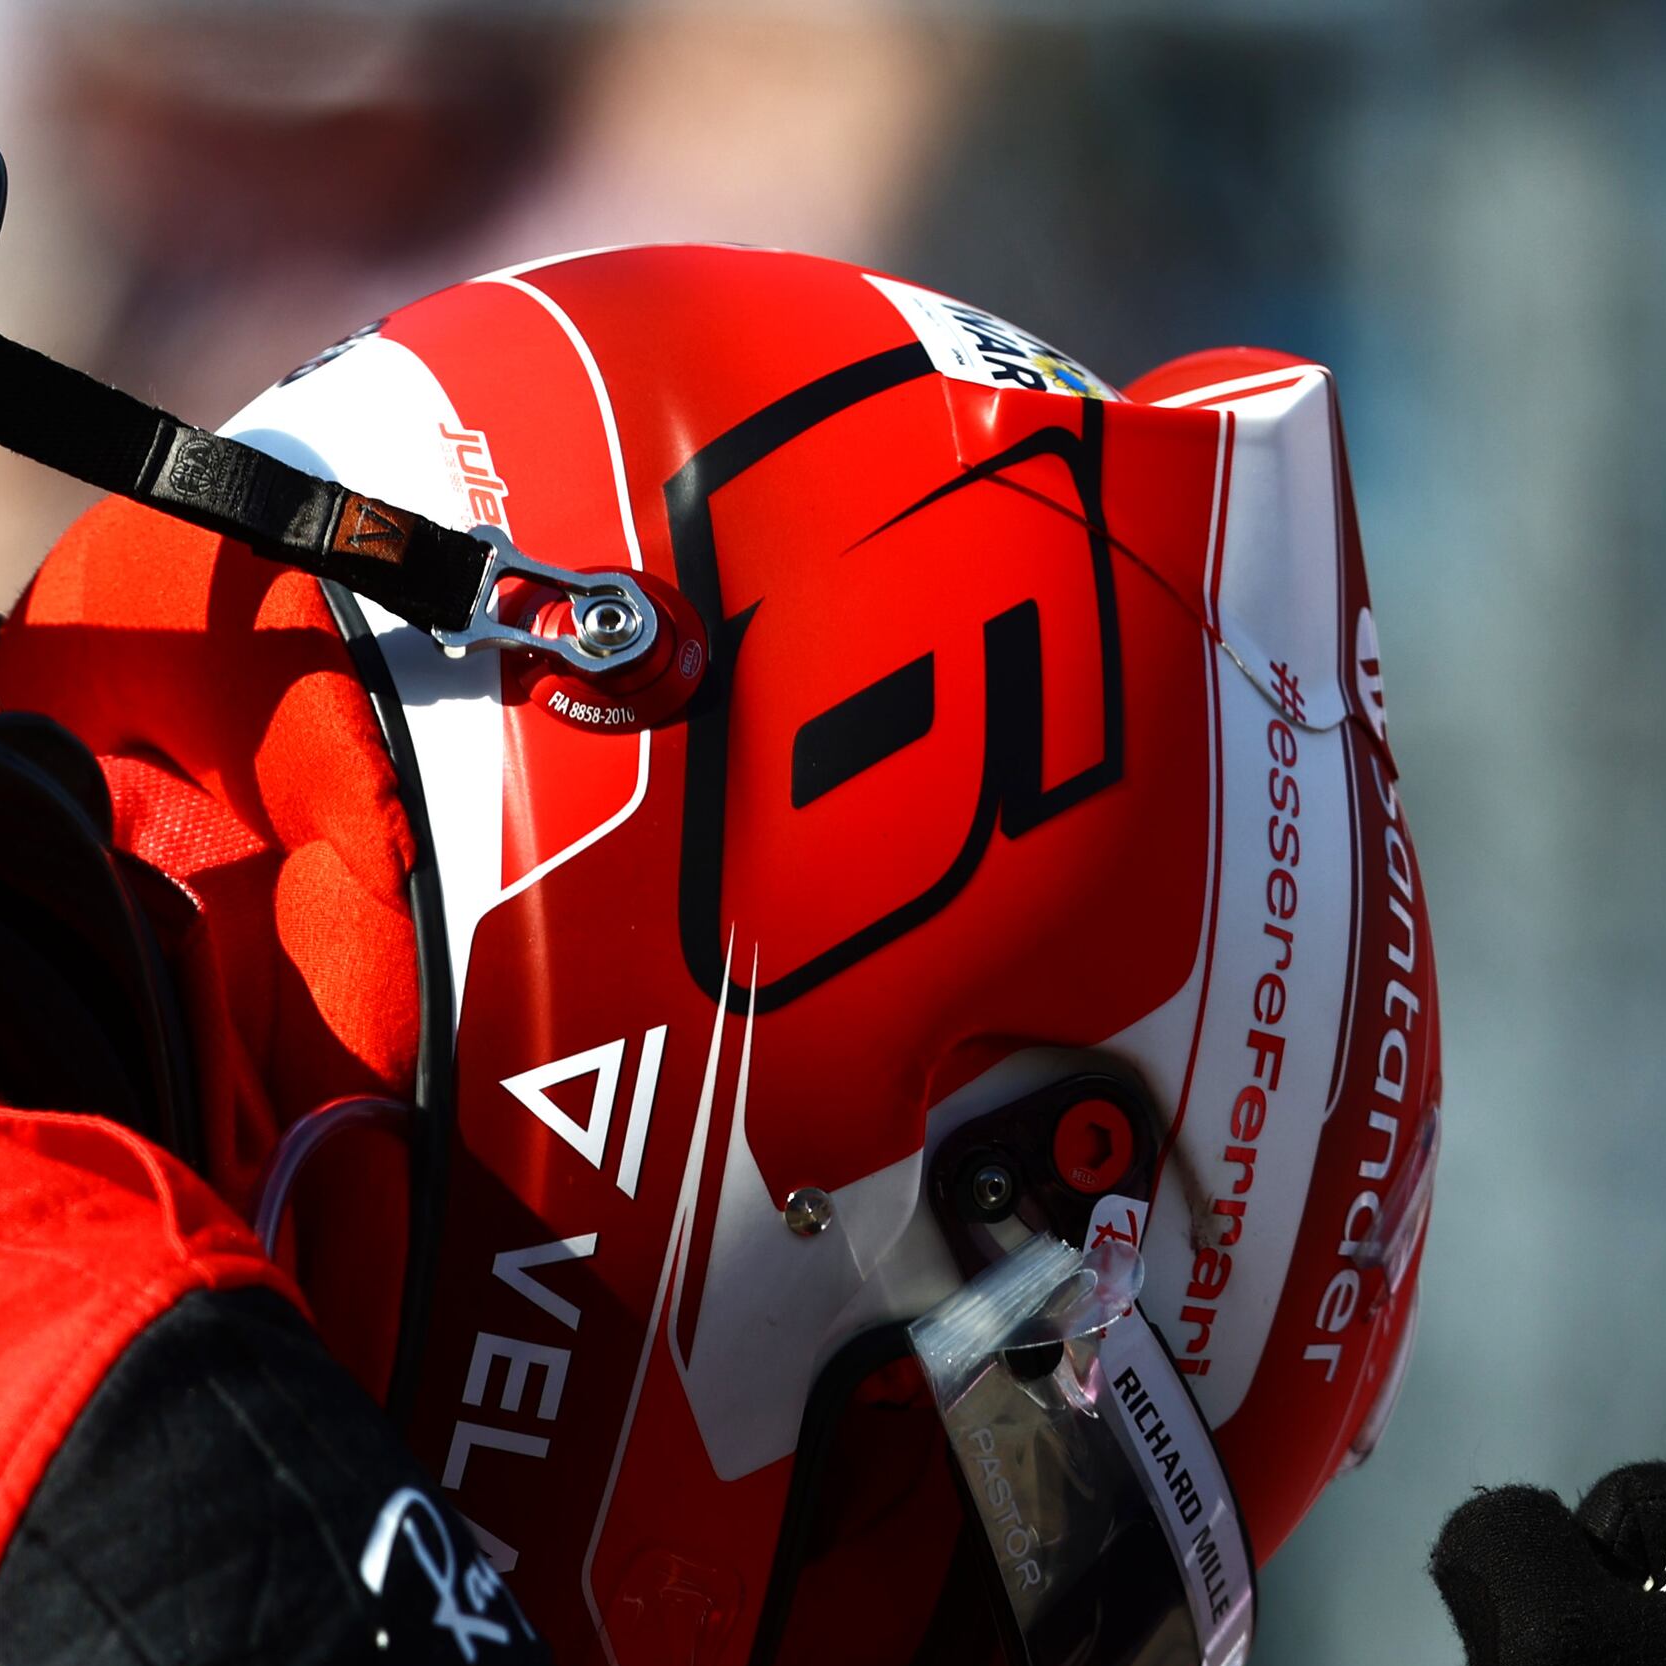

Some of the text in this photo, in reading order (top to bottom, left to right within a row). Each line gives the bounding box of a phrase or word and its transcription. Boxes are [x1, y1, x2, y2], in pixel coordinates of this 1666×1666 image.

[941, 303, 1048, 392] WAR
[547, 690, 636, 724] FIA 8858-2010
[968, 1426, 1042, 1592] PASTOR
[1112, 1366, 1203, 1526] RICHARD
[1191, 1524, 1231, 1625] MILLE
